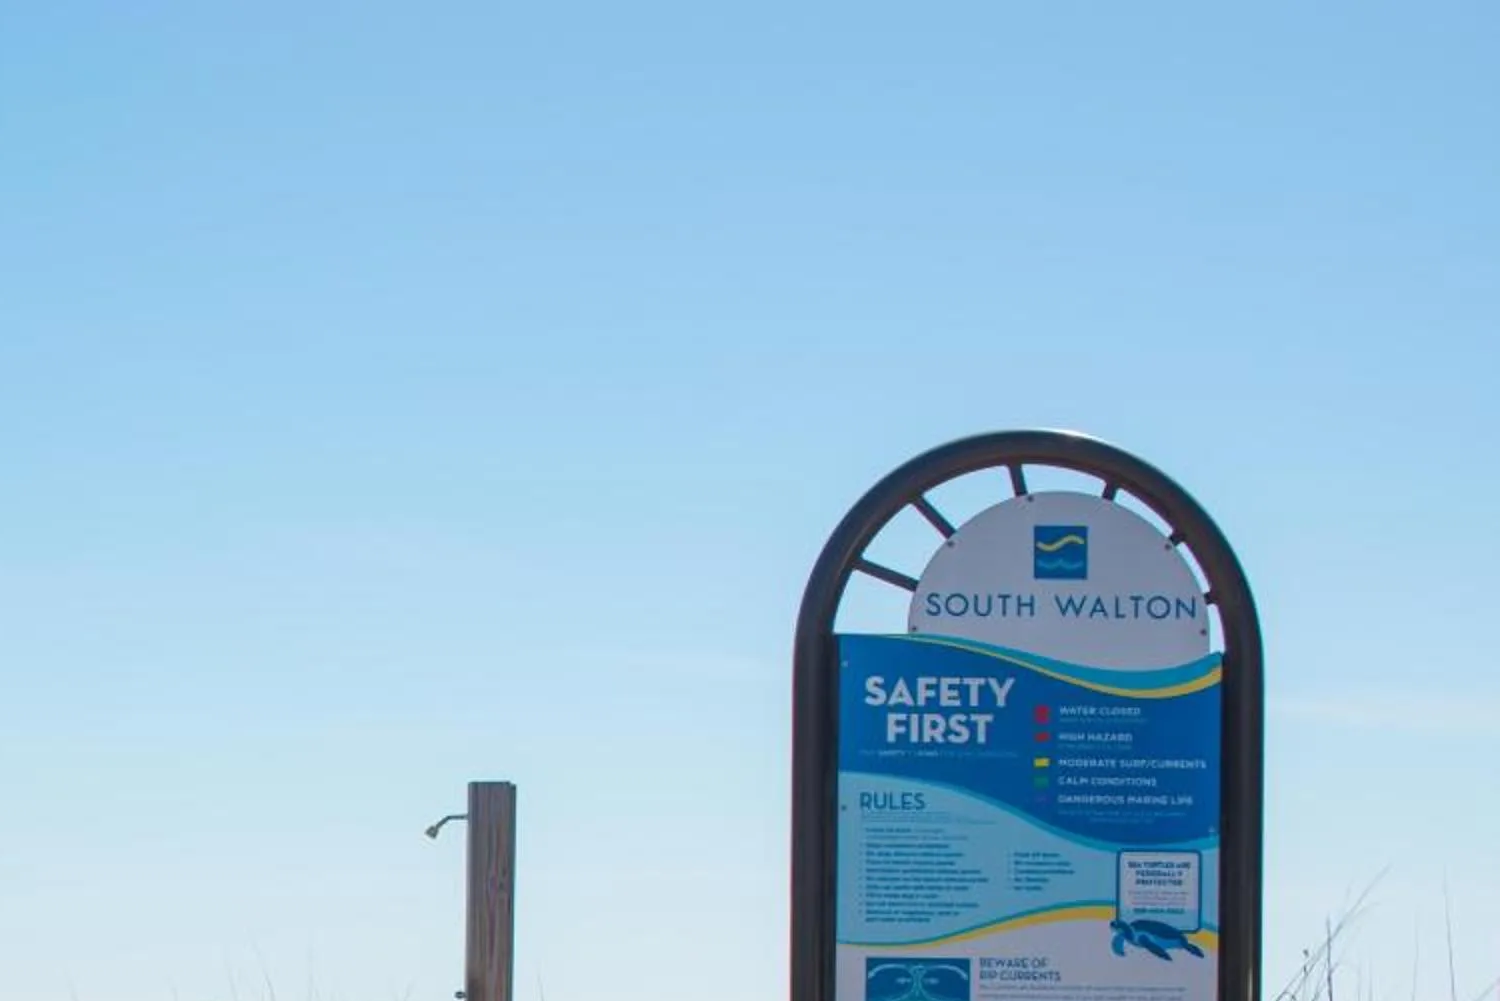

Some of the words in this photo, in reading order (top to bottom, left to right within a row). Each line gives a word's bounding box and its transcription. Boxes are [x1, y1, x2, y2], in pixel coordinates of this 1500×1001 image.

[926, 593, 1035, 617] SOUTH
[1054, 594, 1197, 619] WALTON
[865, 675, 1016, 708] SAFETY
[1060, 706, 1097, 716] WATER
[1099, 706, 1141, 716] CLOSED
[886, 713, 994, 744] FIRST
[1058, 732, 1085, 742] HIGH
[1087, 732, 1133, 742] HAZARD
[1058, 758, 1116, 768] MODERATE
[1119, 758, 1207, 769] SURF/CURRENTS
[1058, 776, 1088, 786] CALM
[1091, 776, 1157, 787] CONDITIONS
[860, 791, 926, 811] RULES
[1058, 794, 1125, 805] DANGEROUS
[1127, 795, 1168, 805] MARINE
[1171, 795, 1193, 806] LIFE
[979, 957, 1028, 968] BEWARE
[1031, 958, 1048, 968] OF
[979, 970, 998, 980] RIP
[1001, 970, 1062, 981] CURRENTS
